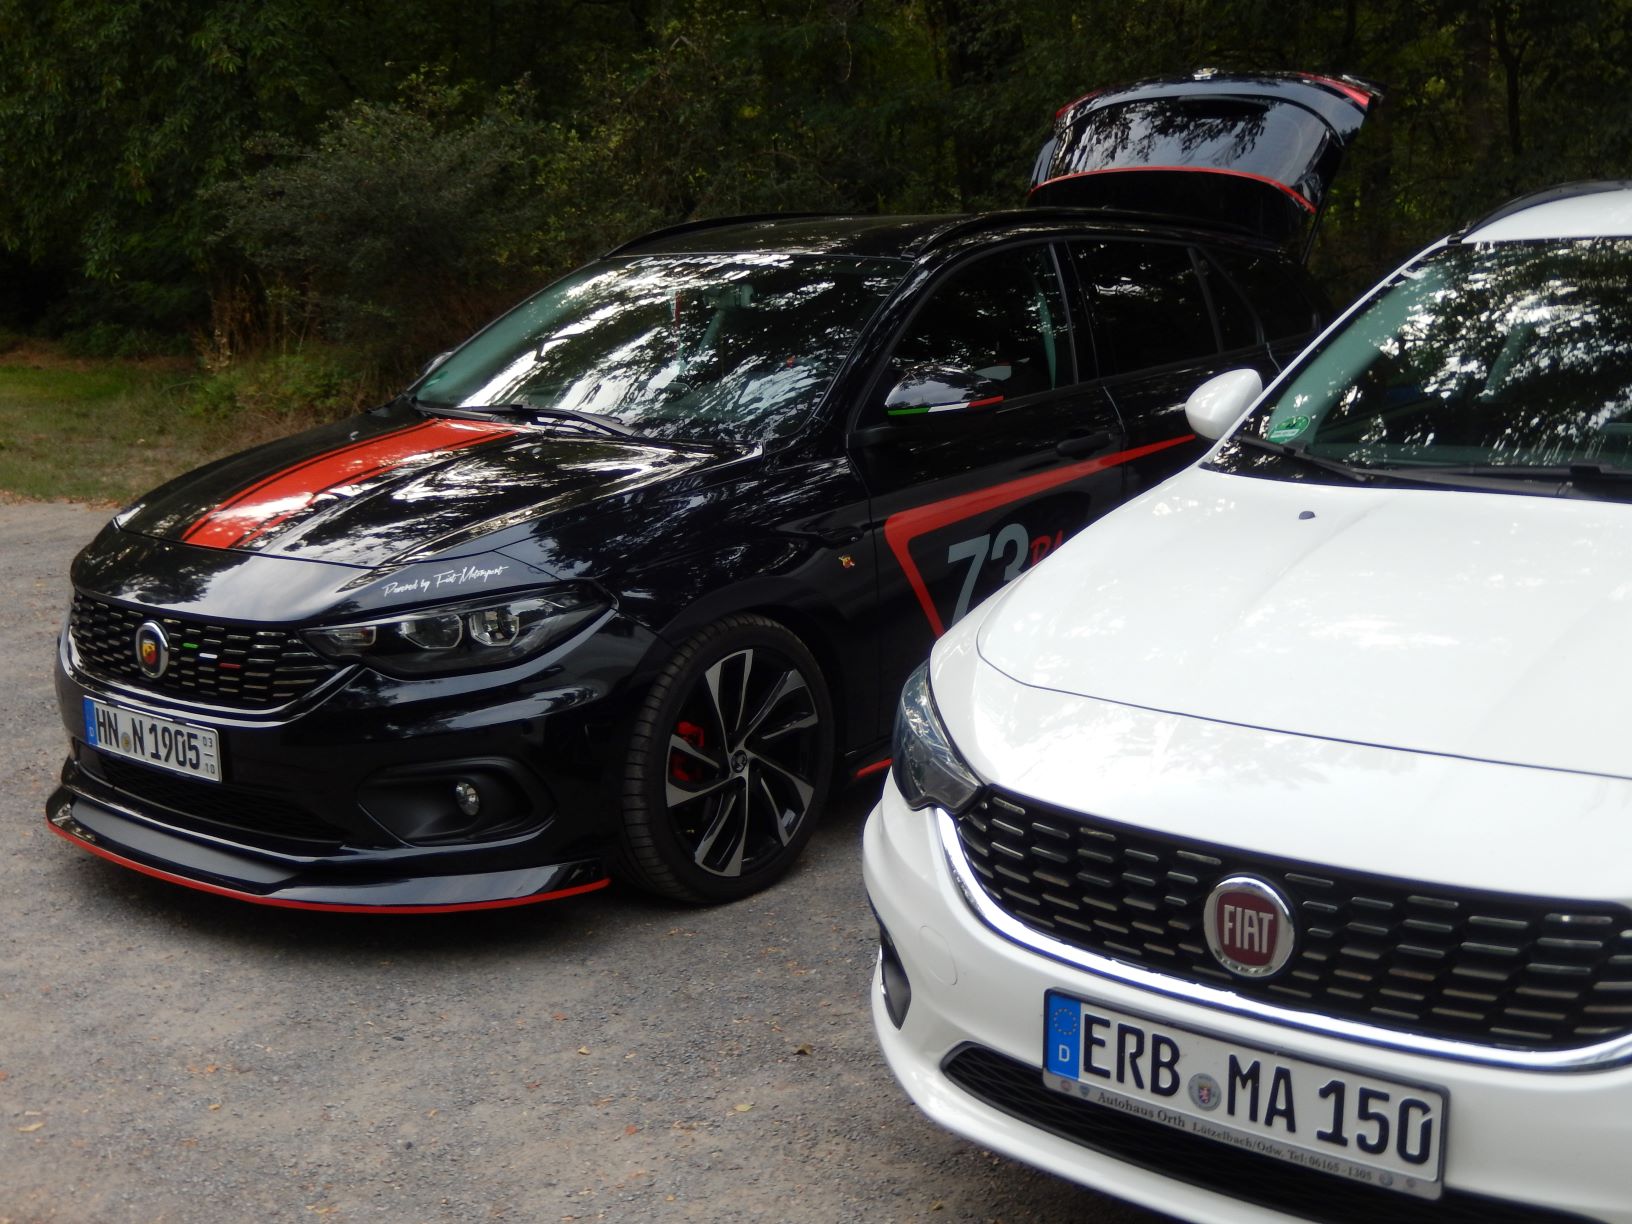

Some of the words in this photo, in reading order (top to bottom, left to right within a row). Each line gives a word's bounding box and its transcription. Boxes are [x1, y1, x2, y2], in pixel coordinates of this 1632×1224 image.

[382, 580, 418, 597] Powered
[420, 579, 431, 592] by
[434, 570, 460, 588] Fiat
[948, 523, 1030, 627] 73
[96, 707, 120, 748] HN
[131, 718, 145, 756] N
[149, 723, 200, 770] 1905
[1224, 904, 1274, 954] FIAT
[1058, 1044, 1071, 1063] D
[1083, 1013, 1181, 1098] ERB
[1226, 1054, 1297, 1133] MA
[1316, 1079, 1433, 1165] 150
[1098, 1091, 1154, 1119] Autohaus
[1157, 1109, 1186, 1128] Orth
